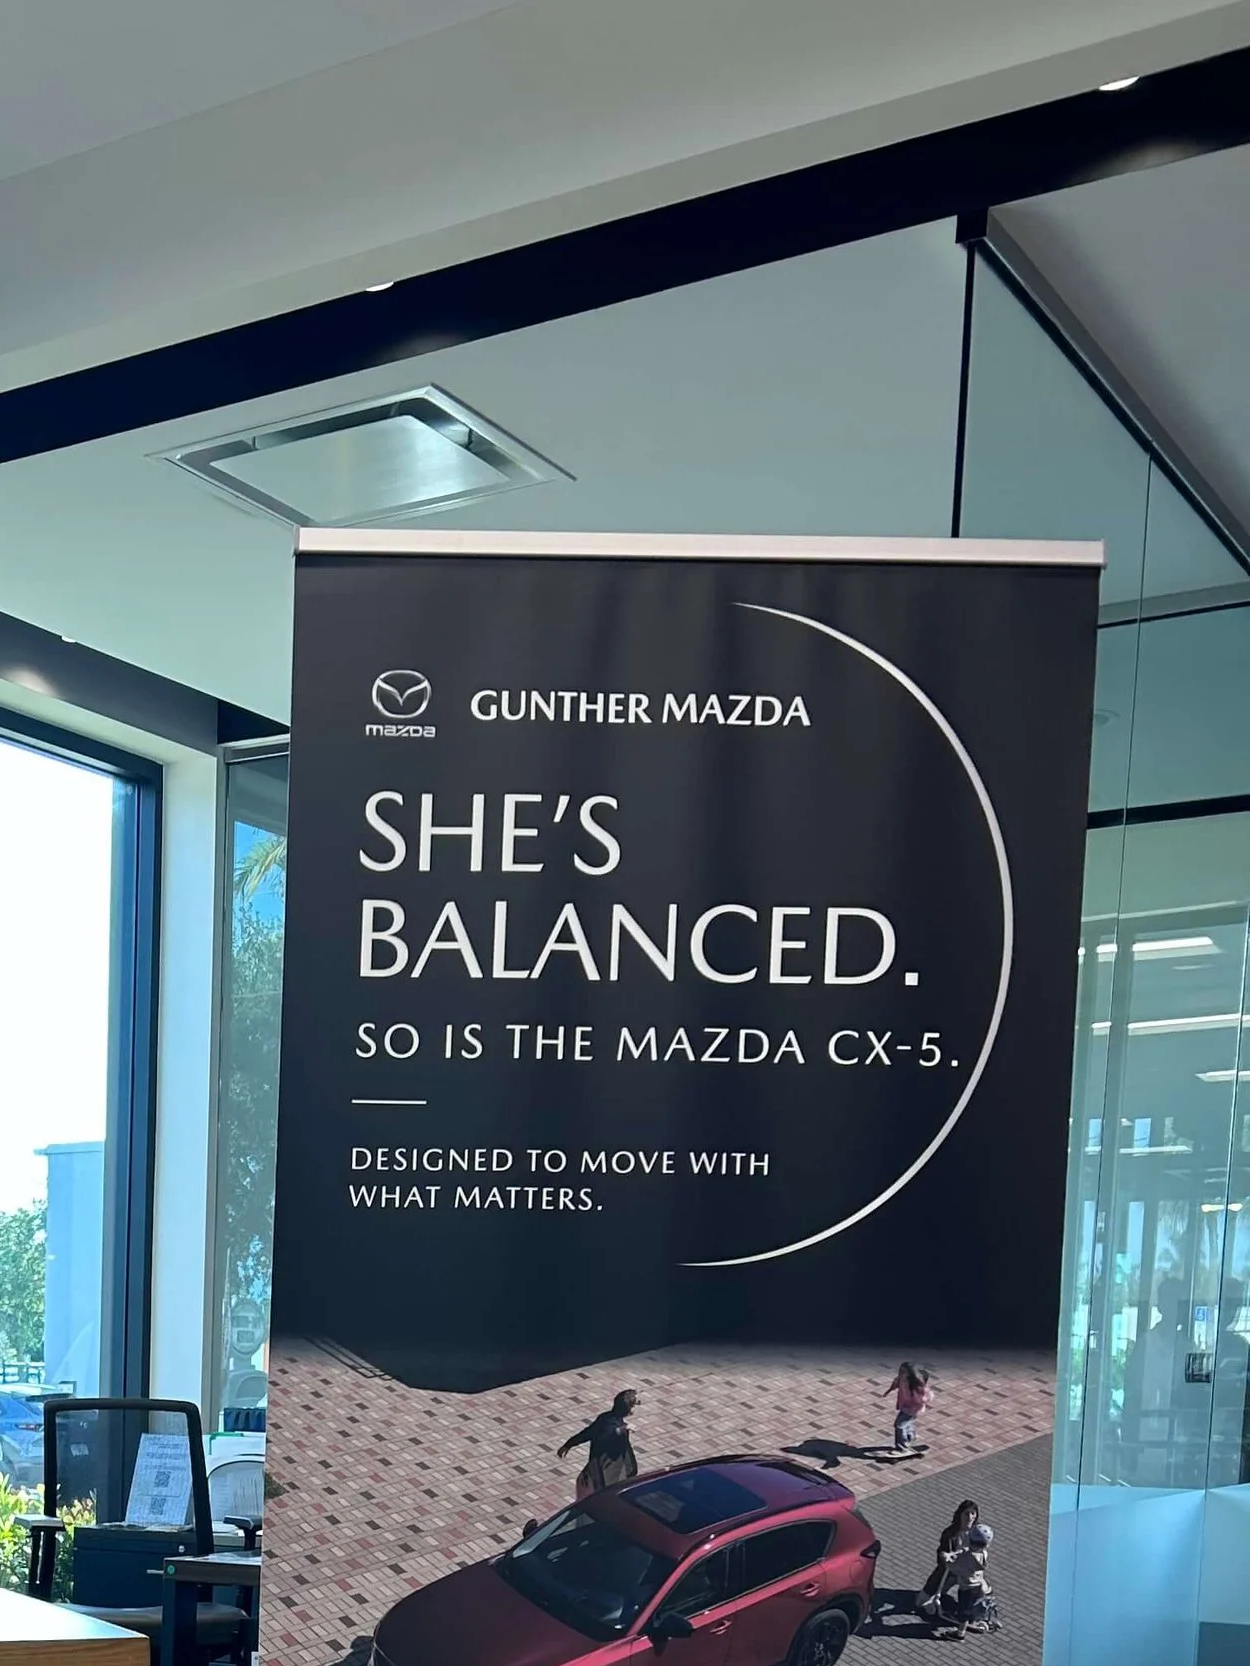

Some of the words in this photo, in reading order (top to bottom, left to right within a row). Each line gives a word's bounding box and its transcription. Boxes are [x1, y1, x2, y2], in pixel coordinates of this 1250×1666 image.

[470, 689, 653, 724] GUNTHER
[661, 693, 812, 727] MAZDA
[359, 790, 621, 876] SHE'S
[359, 899, 919, 986] BALANCED.
[355, 1022, 420, 1059] SO
[445, 1023, 483, 1059] IS
[505, 1024, 593, 1061] THE
[616, 1026, 805, 1064] MAZDA
[828, 1030, 959, 1067] CX-5.
[351, 1147, 513, 1172] DESIGNED
[526, 1149, 567, 1173] TO
[580, 1150, 675, 1174] MOVE
[689, 1151, 769, 1176] WITH
[349, 1184, 441, 1209] WHAT
[454, 1186, 603, 1211] MATTERS.
